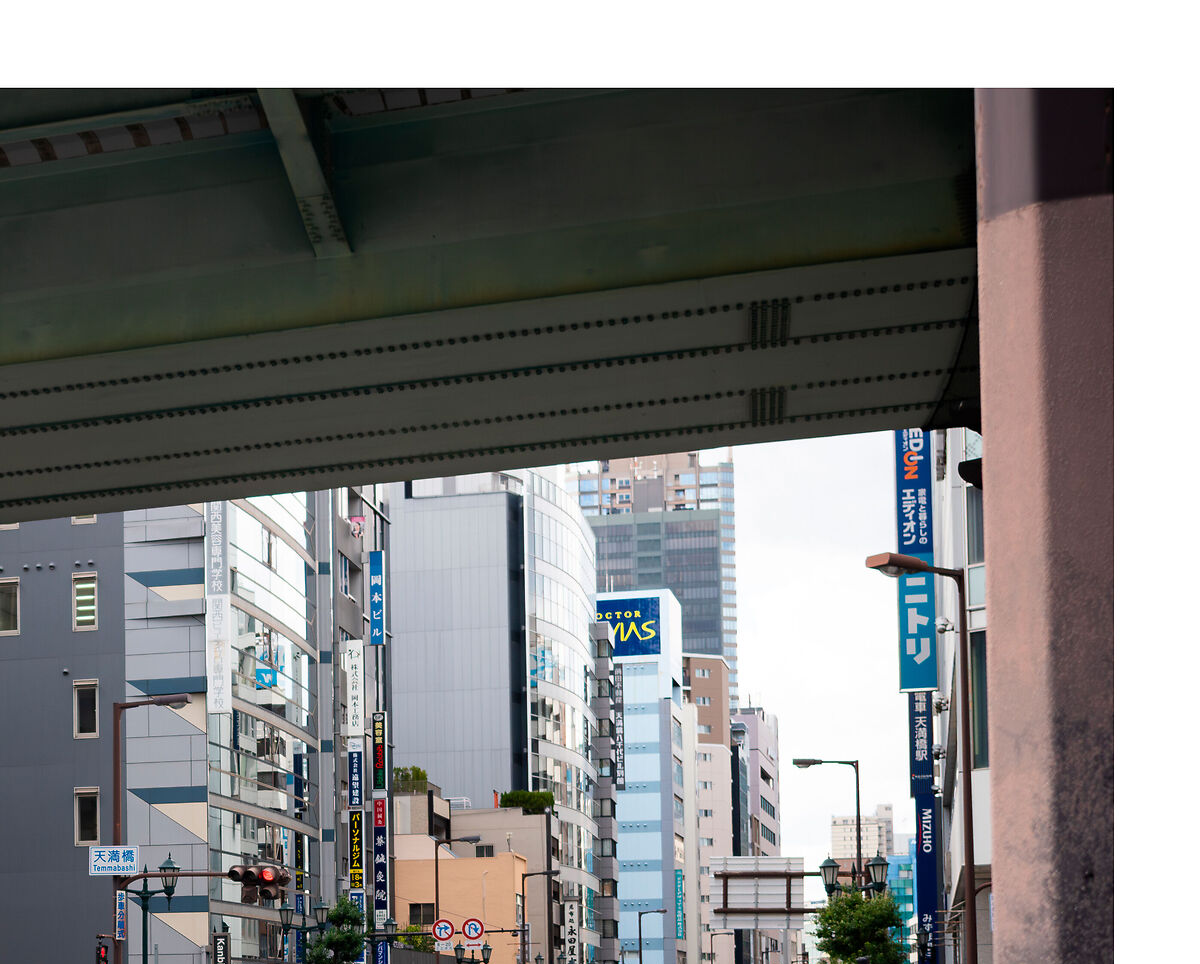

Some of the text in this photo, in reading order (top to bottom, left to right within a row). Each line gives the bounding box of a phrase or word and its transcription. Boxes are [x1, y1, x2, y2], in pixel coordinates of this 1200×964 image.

[902, 489, 917, 546] エディオン
[371, 575, 382, 637] 岡本ビル
[904, 577, 931, 665] ニトリ
[914, 716, 928, 761] 天満橋駅
[352, 812, 360, 868] パーソナルジム
[922, 808, 932, 853] MIZUHO
[93, 864, 136, 872] Temmabashi
[94, 850, 135, 863] 天満橋
